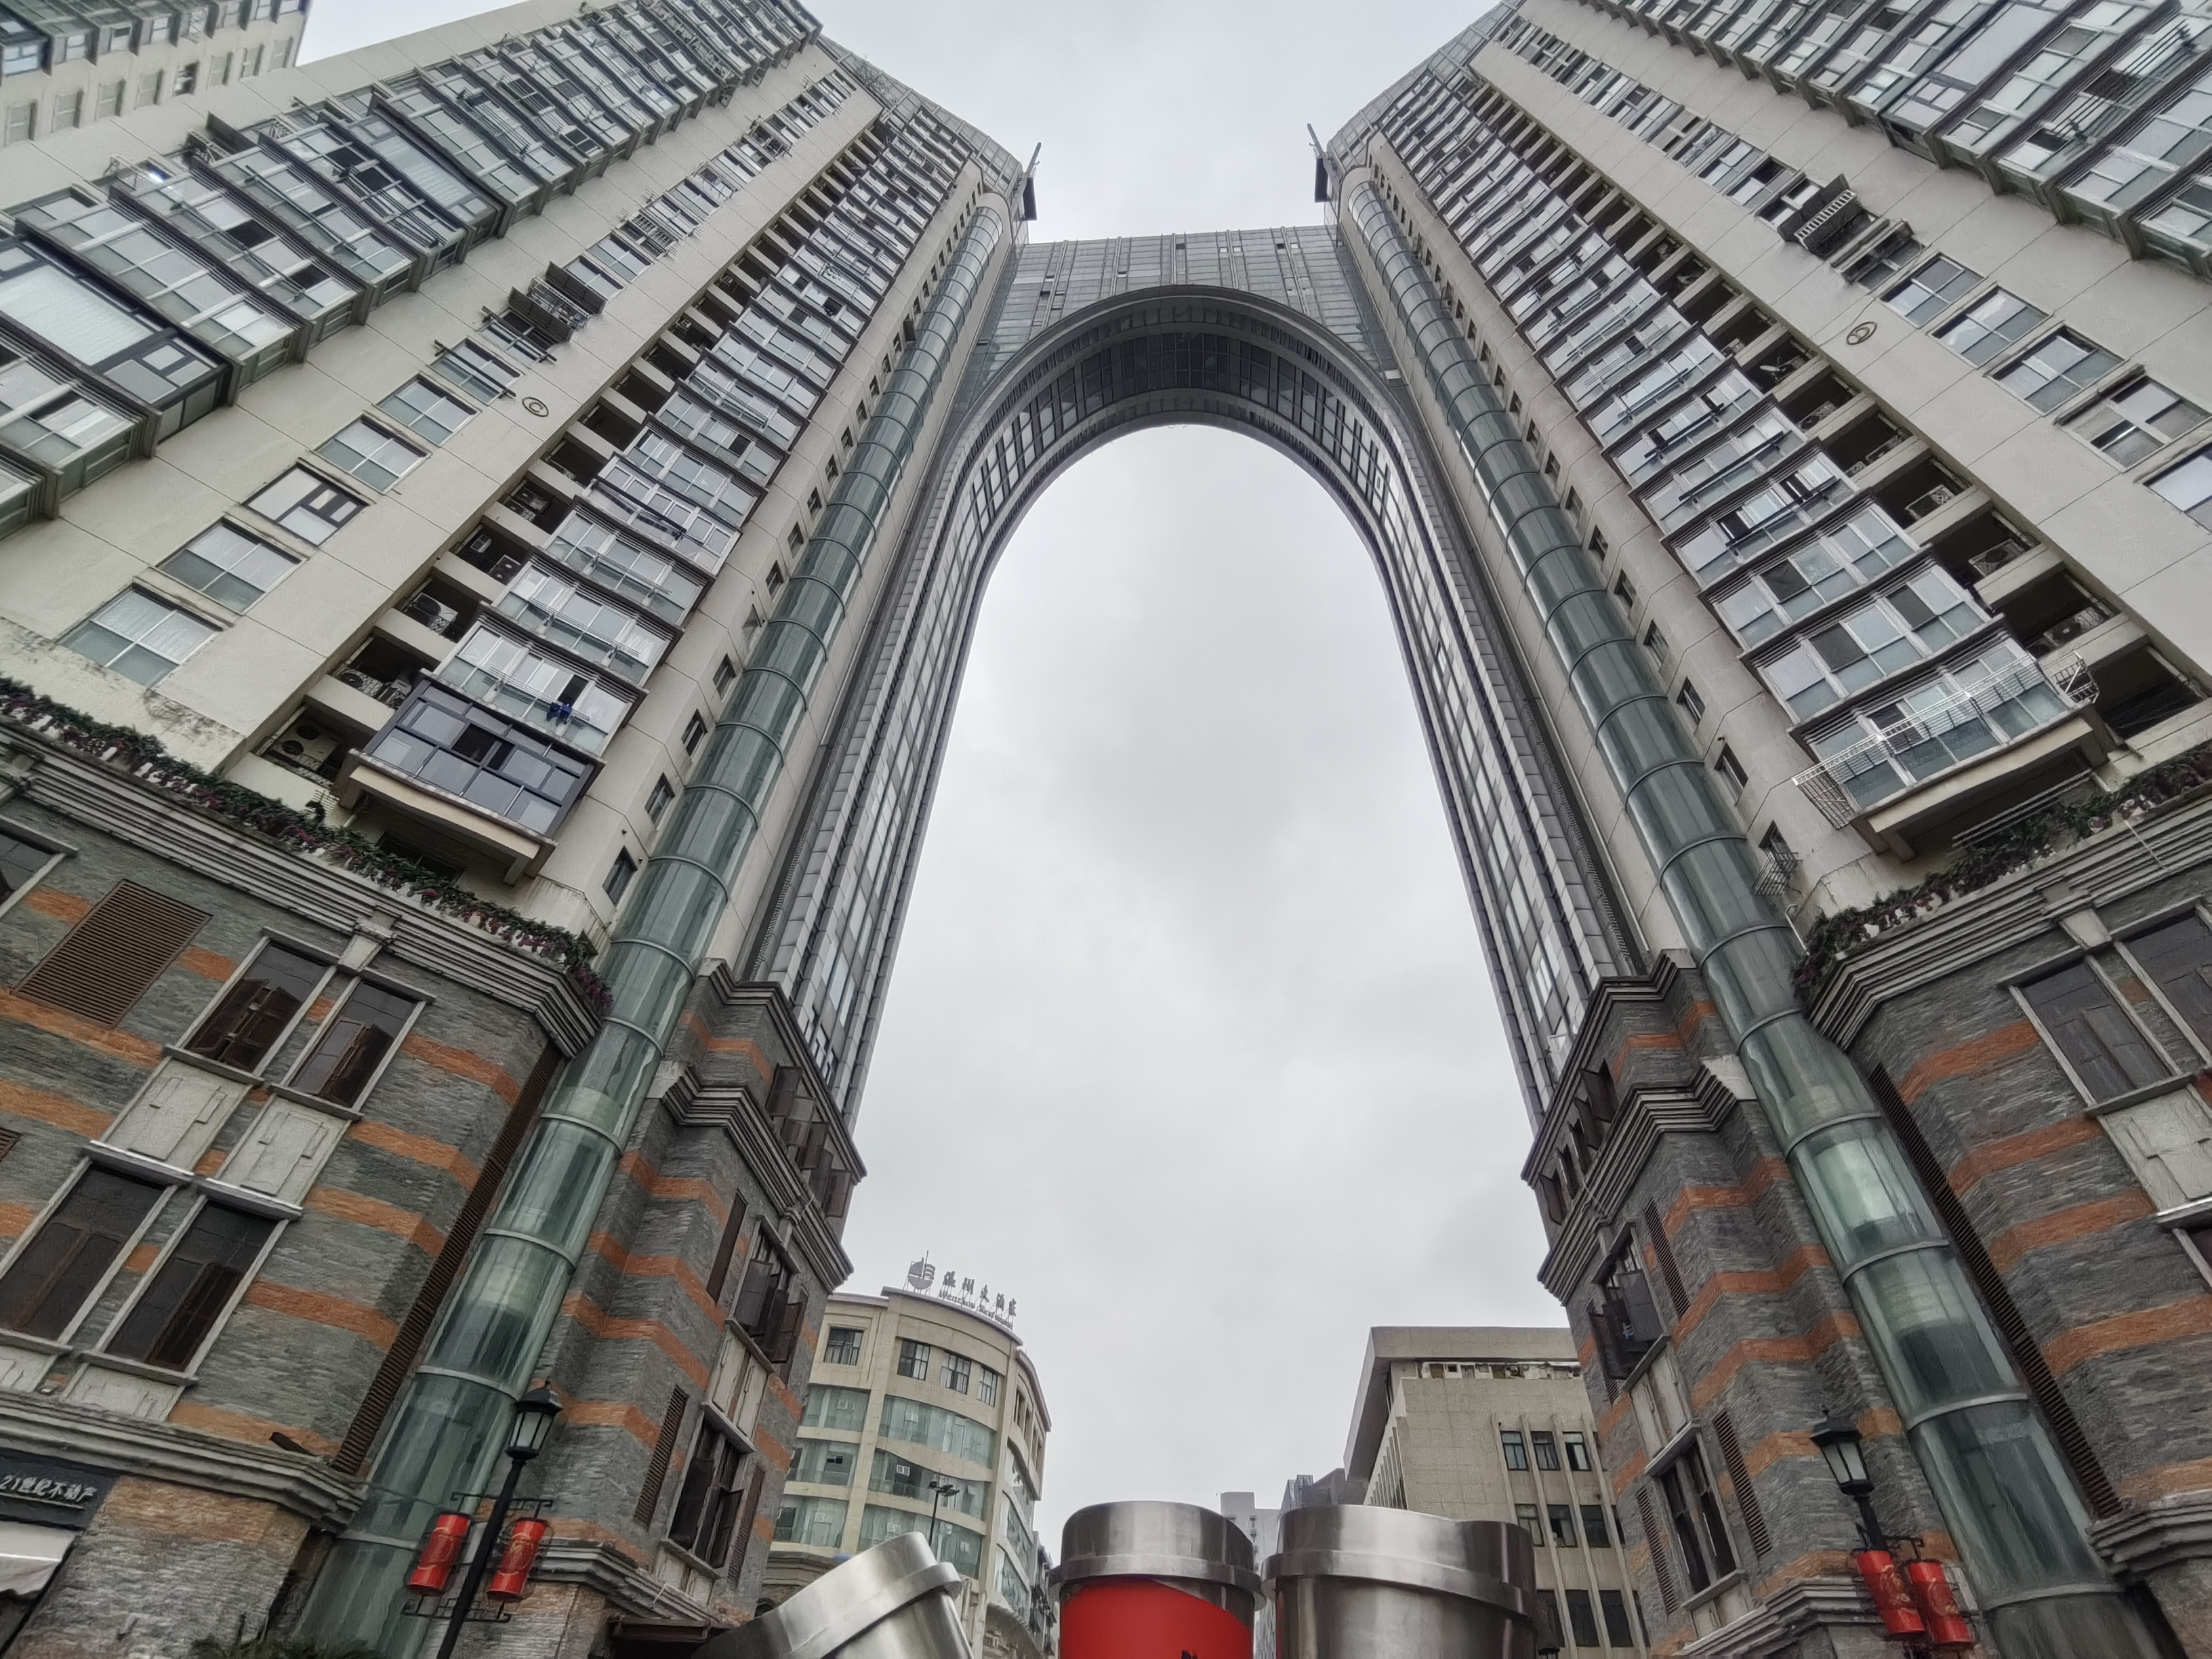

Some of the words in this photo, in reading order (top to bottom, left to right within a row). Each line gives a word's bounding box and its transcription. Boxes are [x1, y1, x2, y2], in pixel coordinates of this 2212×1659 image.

[0, 1475, 97, 1502] 21世纪不动产
